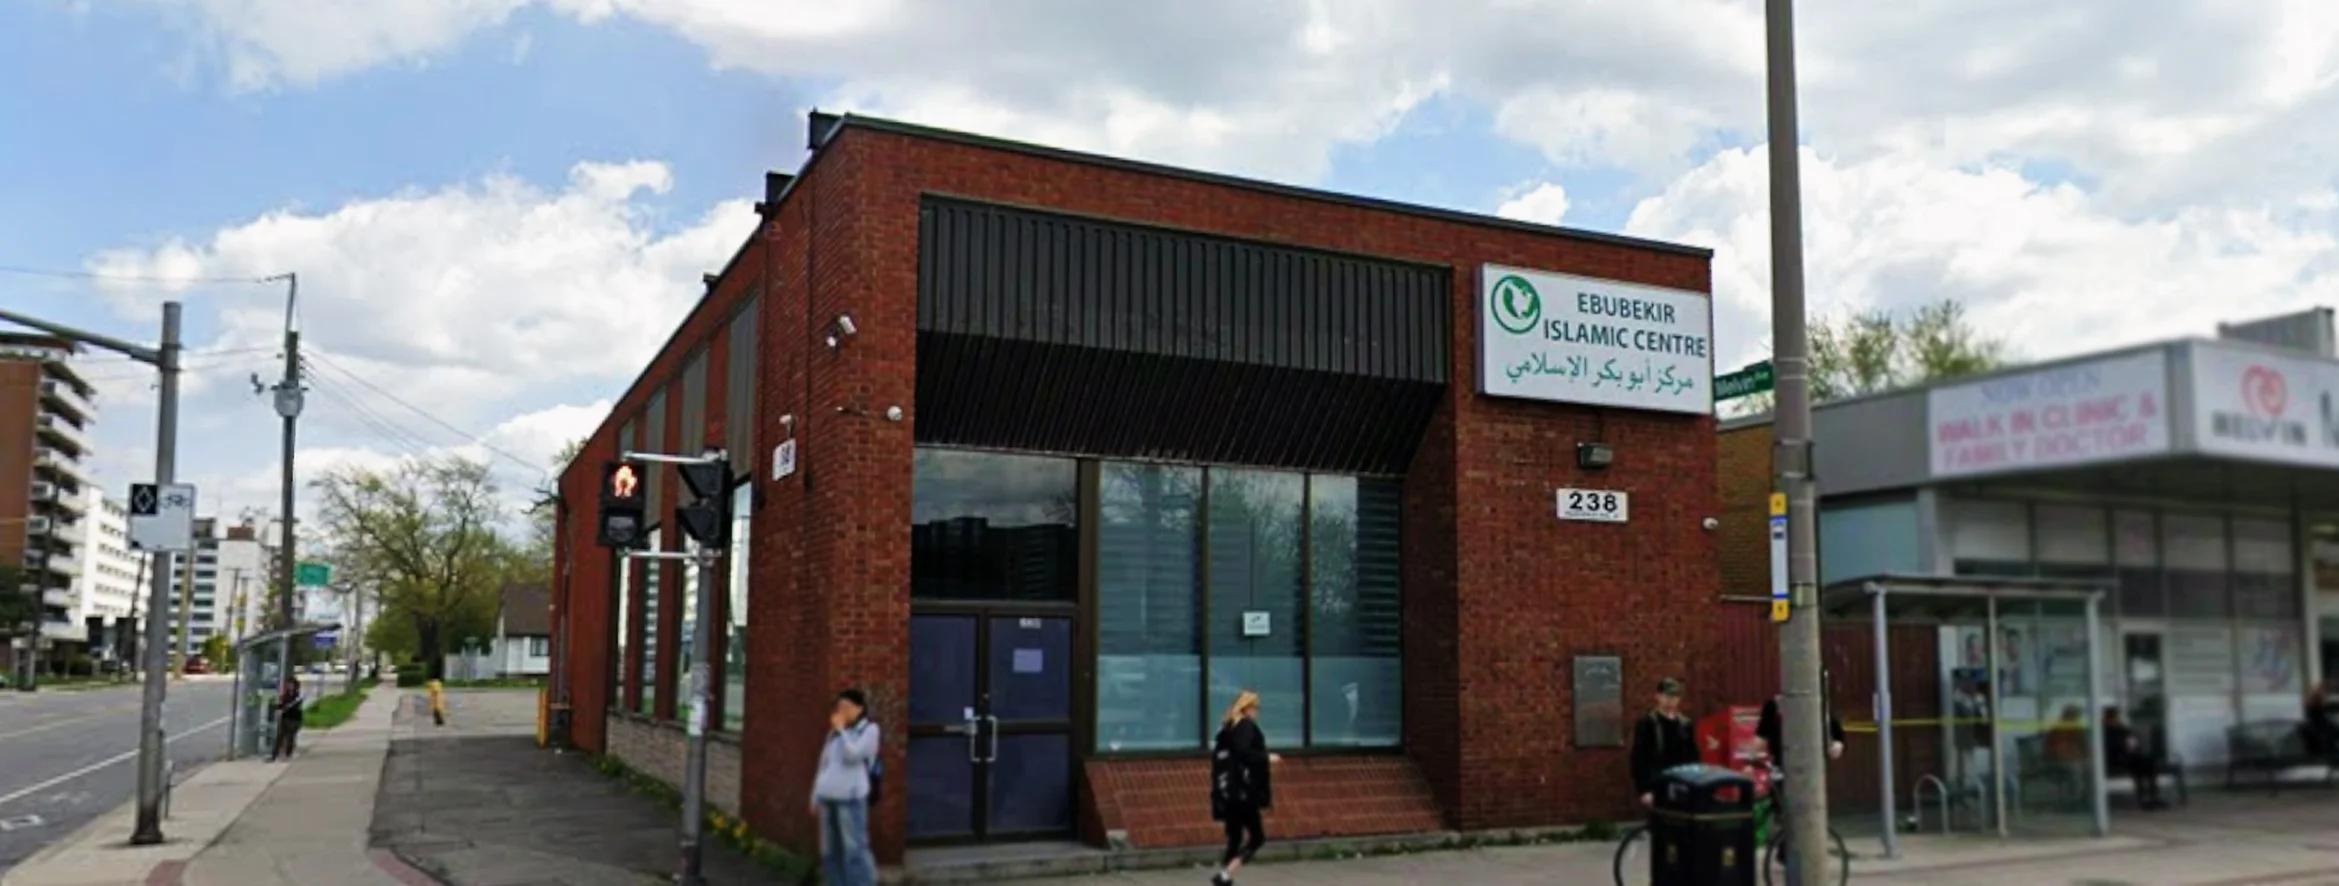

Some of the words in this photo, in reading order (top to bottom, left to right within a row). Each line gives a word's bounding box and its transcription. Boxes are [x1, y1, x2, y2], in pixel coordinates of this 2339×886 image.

[1577, 292, 1676, 324] EBUBEKIR
[1544, 318, 1629, 349] ISLAMIC
[1634, 329, 1707, 358] CENTRE
[1592, 357, 1623, 388] بكر
[1655, 364, 1694, 396] مركز
[2010, 408, 2035, 436] IN
[1569, 491, 1618, 512] 238
